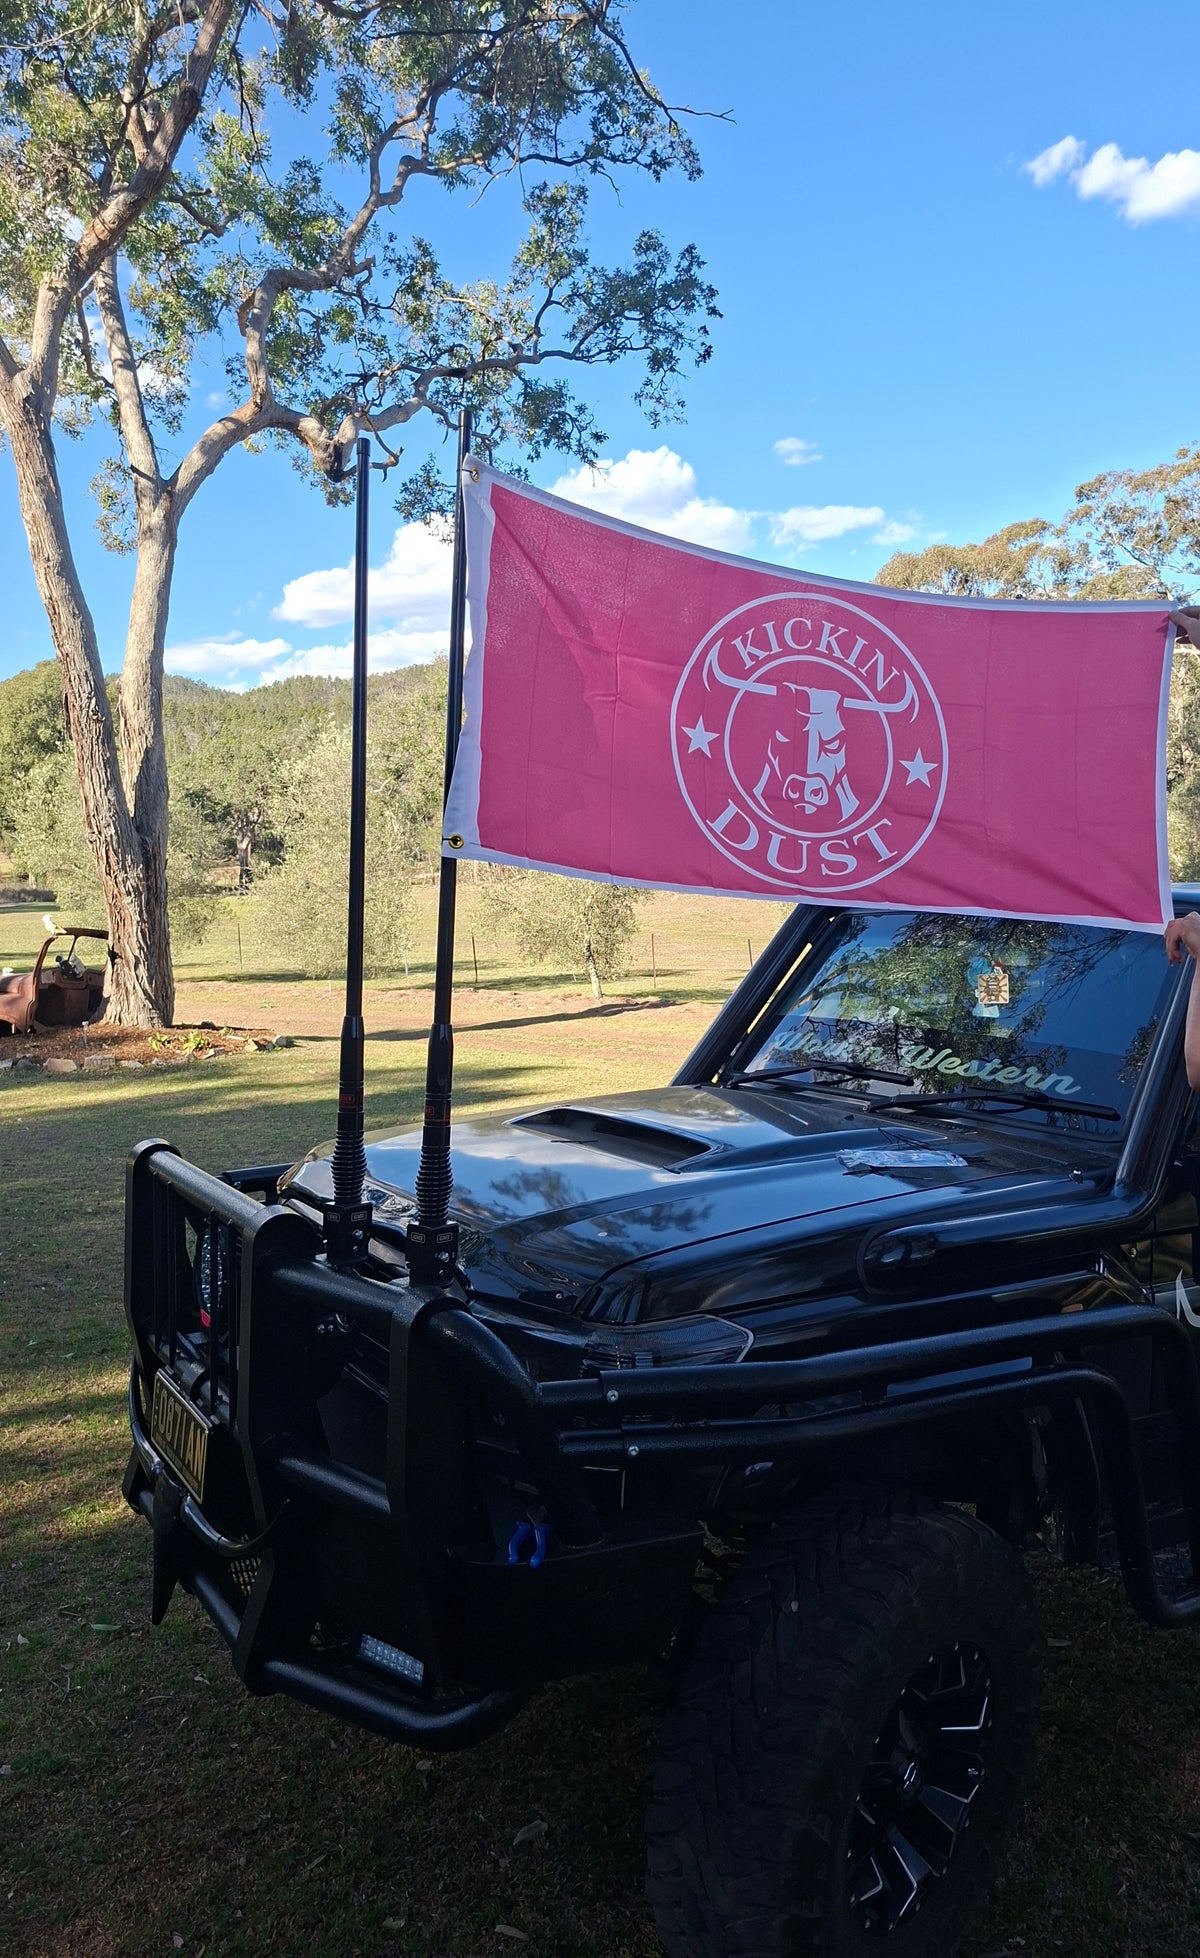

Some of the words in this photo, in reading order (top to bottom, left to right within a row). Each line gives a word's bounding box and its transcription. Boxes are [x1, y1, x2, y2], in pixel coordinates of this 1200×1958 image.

[730, 617, 900, 692] KICKIN
[705, 798, 899, 876] DUST
[901, 1044, 1082, 1095] Western
